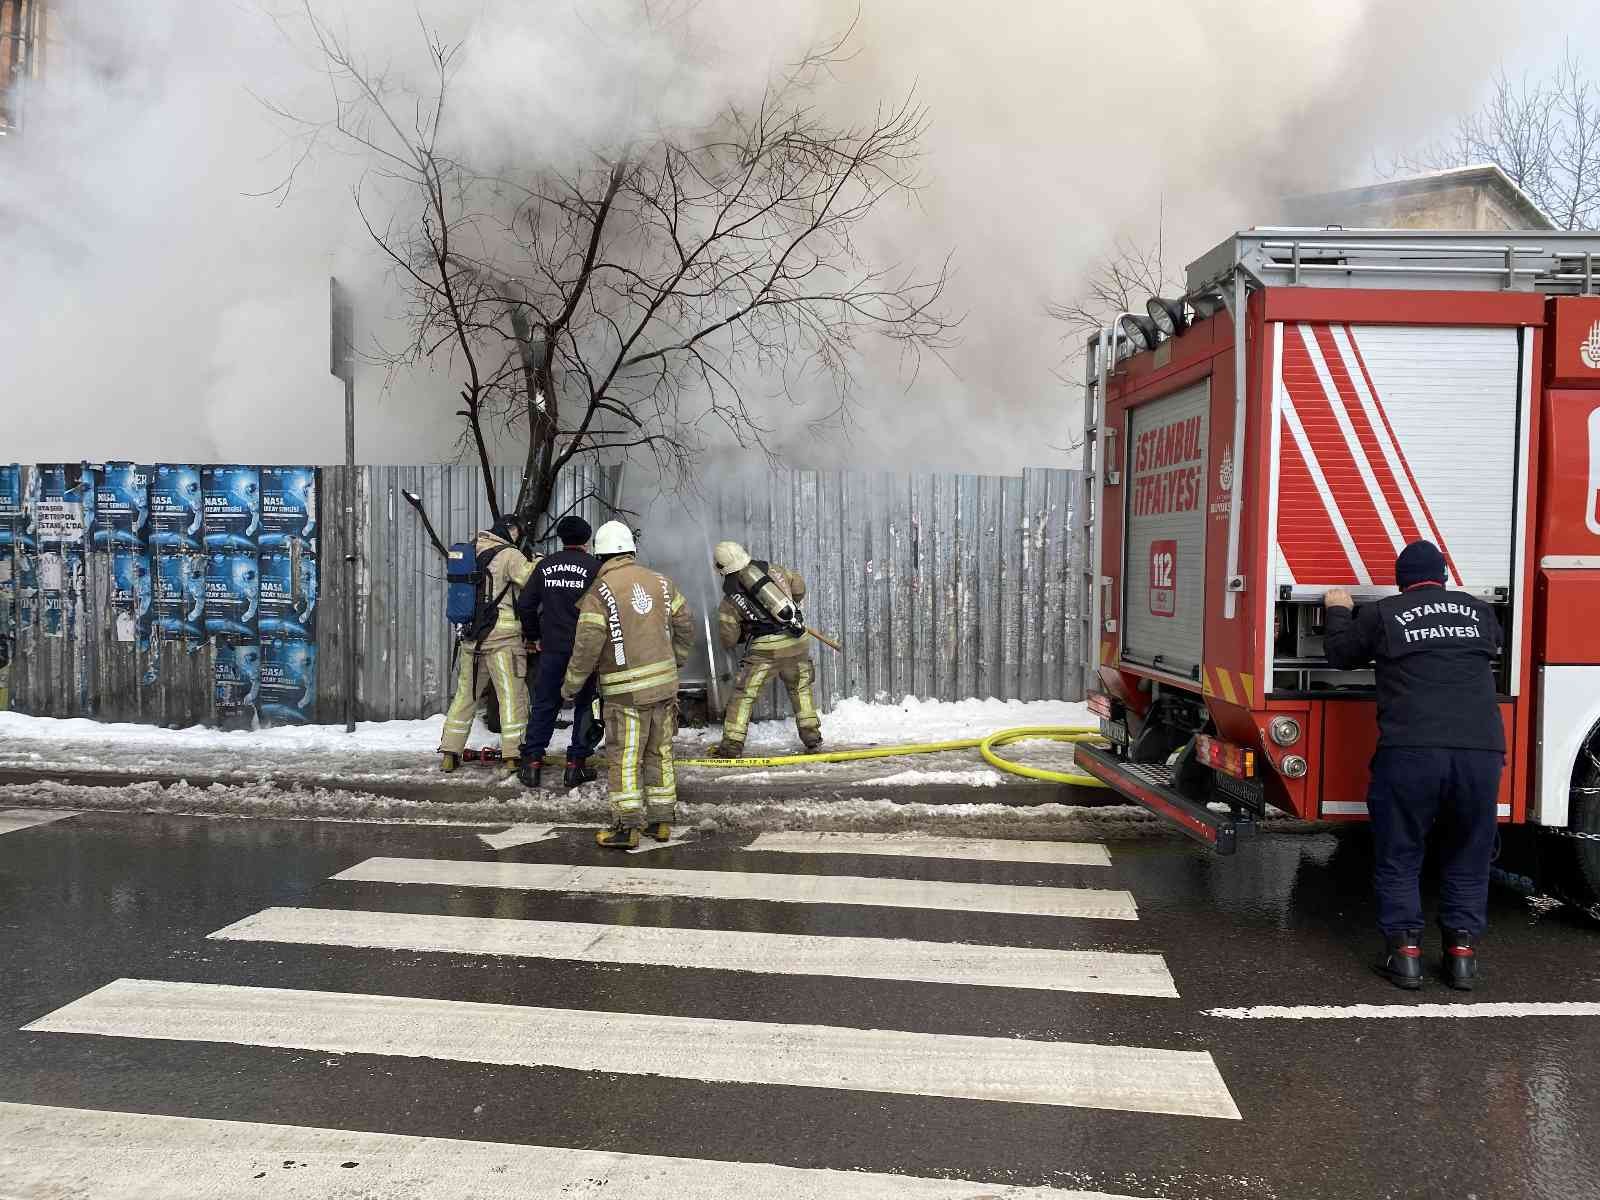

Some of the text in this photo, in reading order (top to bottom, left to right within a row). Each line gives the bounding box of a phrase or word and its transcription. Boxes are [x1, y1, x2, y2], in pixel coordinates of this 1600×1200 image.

[1135, 415, 1201, 474] İSTANBUL
[1134, 465, 1201, 516] İTFAİYESİ
[205, 497, 228, 506] NASA
[263, 497, 284, 506] NASA
[542, 563, 588, 578] İSTANBUL
[1153, 552, 1173, 587] 112
[261, 582, 282, 592] NASA
[544, 577, 584, 589] İTFAİYESİ
[598, 582, 624, 643] İSTANBUL
[1395, 602, 1480, 626] İSTANBUL
[1404, 624, 1480, 643] İTFAİYESİ
